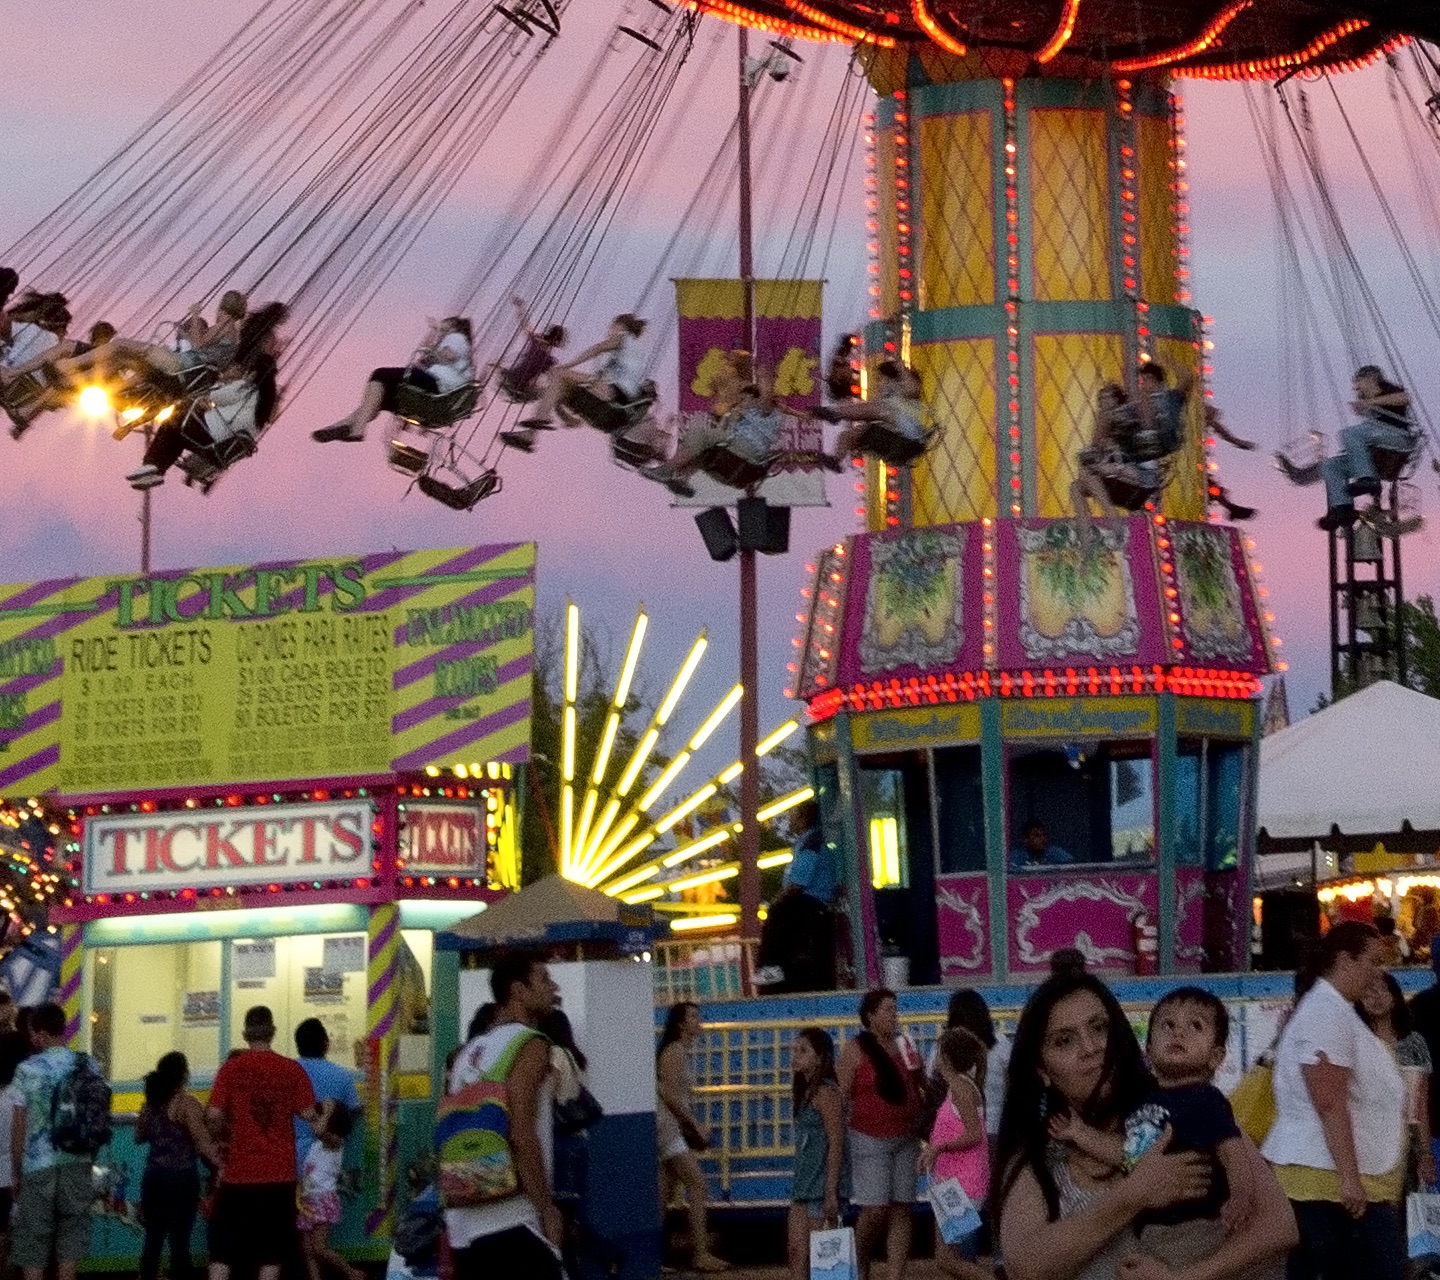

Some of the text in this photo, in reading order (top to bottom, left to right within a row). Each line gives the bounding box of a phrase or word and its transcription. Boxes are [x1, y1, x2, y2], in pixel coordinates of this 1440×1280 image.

[104, 560, 367, 629] TICKETS
[71, 628, 212, 673] RIDE TICKETS
[97, 812, 365, 877] TICKETS
